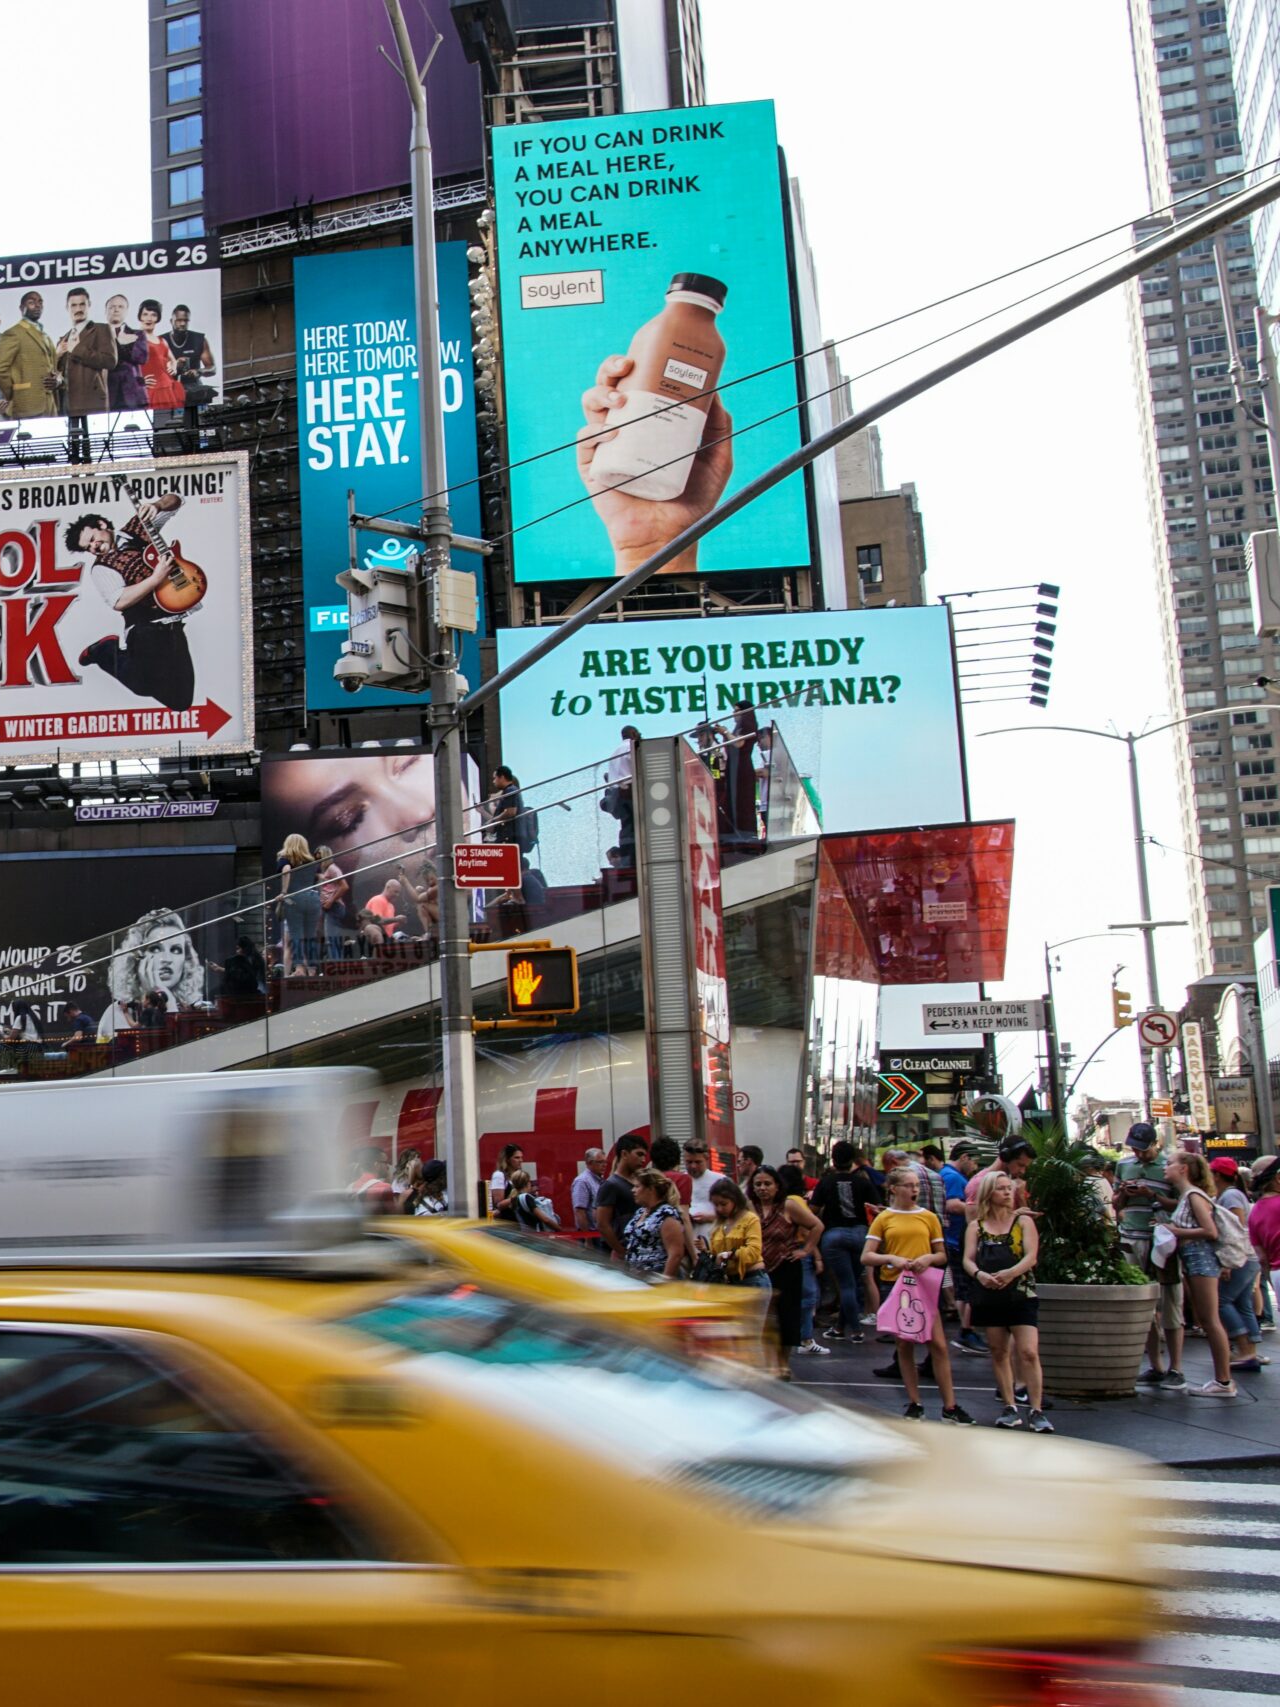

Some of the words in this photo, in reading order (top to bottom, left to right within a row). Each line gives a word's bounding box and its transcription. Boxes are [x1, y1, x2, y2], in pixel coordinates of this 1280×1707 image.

[514, 140, 532, 157] IF
[540, 134, 587, 154] YOU
[595, 130, 644, 150] CAN
[652, 122, 725, 145] DRINK
[514, 166, 529, 182] A
[538, 160, 599, 180] MEAL
[606, 153, 675, 174] HERE,
[515, 188, 562, 208] YOU
[570, 182, 619, 202] CAN
[628, 176, 701, 198] DRINK
[518, 216, 532, 233] A
[540, 210, 602, 232] MEAL
[111, 248, 168, 273] AUG
[176, 244, 208, 266] 26
[518, 232, 657, 259] ANYWHERE.
[528, 278, 596, 304] soylent
[304, 324, 348, 350] HERE
[353, 319, 410, 346] TODAY.
[305, 350, 350, 376] HERE
[354, 340, 464, 372] TOMORW.
[305, 372, 405, 424] HERE
[308, 420, 410, 470] STAY.
[18, 481, 122, 510] BROADWAY
[580, 648, 652, 678] ARE
[658, 644, 732, 673] YOU
[742, 637, 865, 670] READY
[550, 690, 592, 716] to
[598, 684, 706, 716] TASTE
[4, 718, 63, 737] WINTER
[68, 714, 128, 735] GARDEN
[133, 710, 199, 731] THEATRE
[80, 805, 162, 820] OUTFRONT
[170, 802, 212, 815] PRIME
[457, 849, 468, 857] NO
[470, 848, 504, 858] STANDING
[458, 859, 488, 868] Anytime
[56, 944, 87, 966] BE
[67, 971, 87, 993] TO
[927, 1006, 978, 1018] PEDESTRIAN
[980, 1006, 1002, 1015] FLOW
[1006, 1004, 1027, 1014] ZONE
[973, 1019, 993, 1028] KEEP
[996, 1017, 1028, 1028] MOVING
